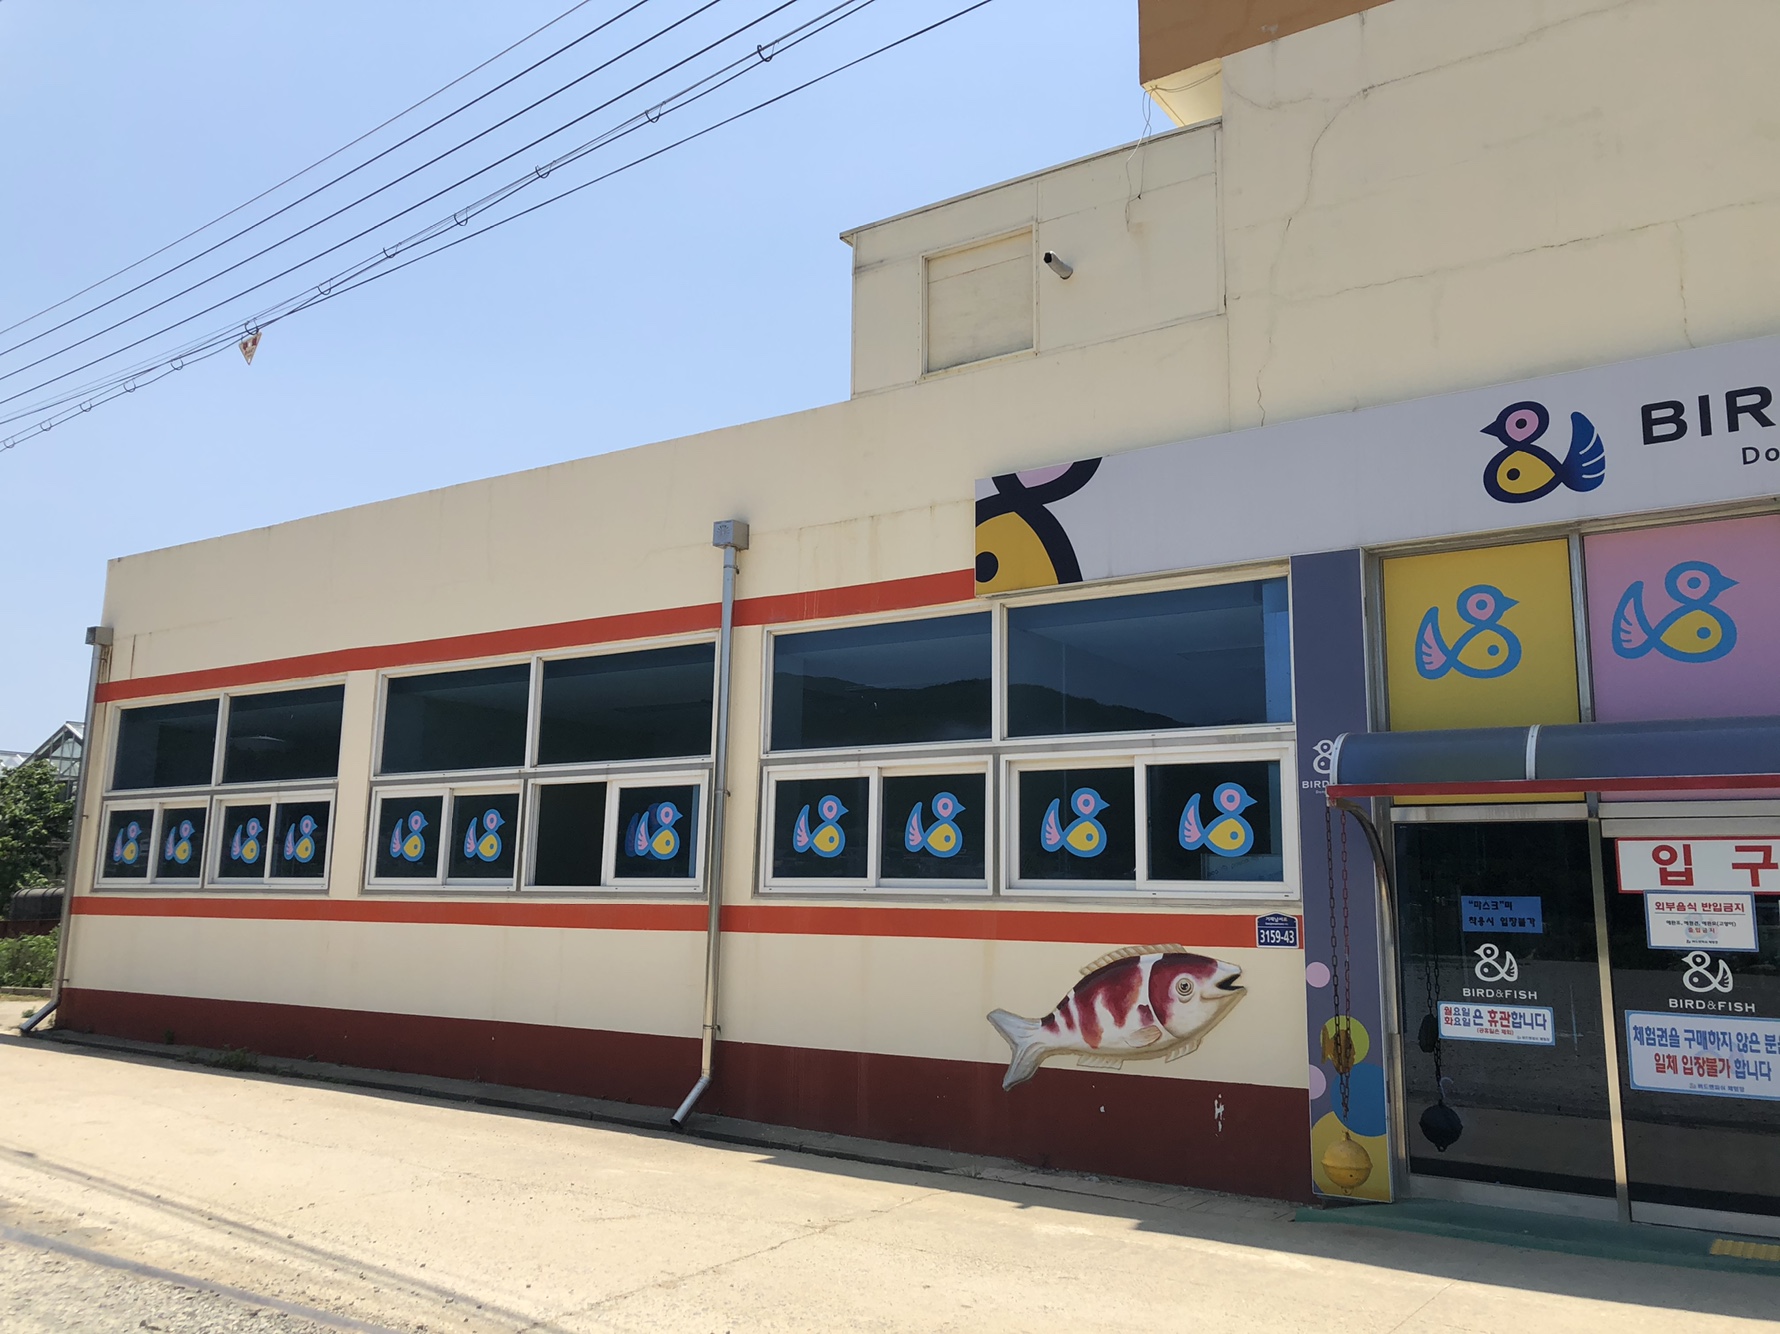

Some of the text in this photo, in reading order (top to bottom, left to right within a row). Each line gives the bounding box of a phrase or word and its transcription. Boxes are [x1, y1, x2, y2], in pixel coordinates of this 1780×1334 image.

[1654, 901, 1745, 913] 외부음식 반입금지
[1468, 916, 1536, 928] 착용시 입장불가
[1260, 930, 1295, 943] 3159-43
[1462, 987, 1538, 1000] BIRD&FISH
[1668, 998, 1756, 1013] BIRD&FISH
[1443, 1006, 1471, 1017] 월요일
[1487, 1009, 1547, 1031] 휴관합니다
[1444, 1016, 1471, 1027] 화요일
[1632, 1025, 1780, 1055] 체험권을 구매하지 않은 분
[1654, 1052, 1772, 1081] 일체 입장불가 합니다
